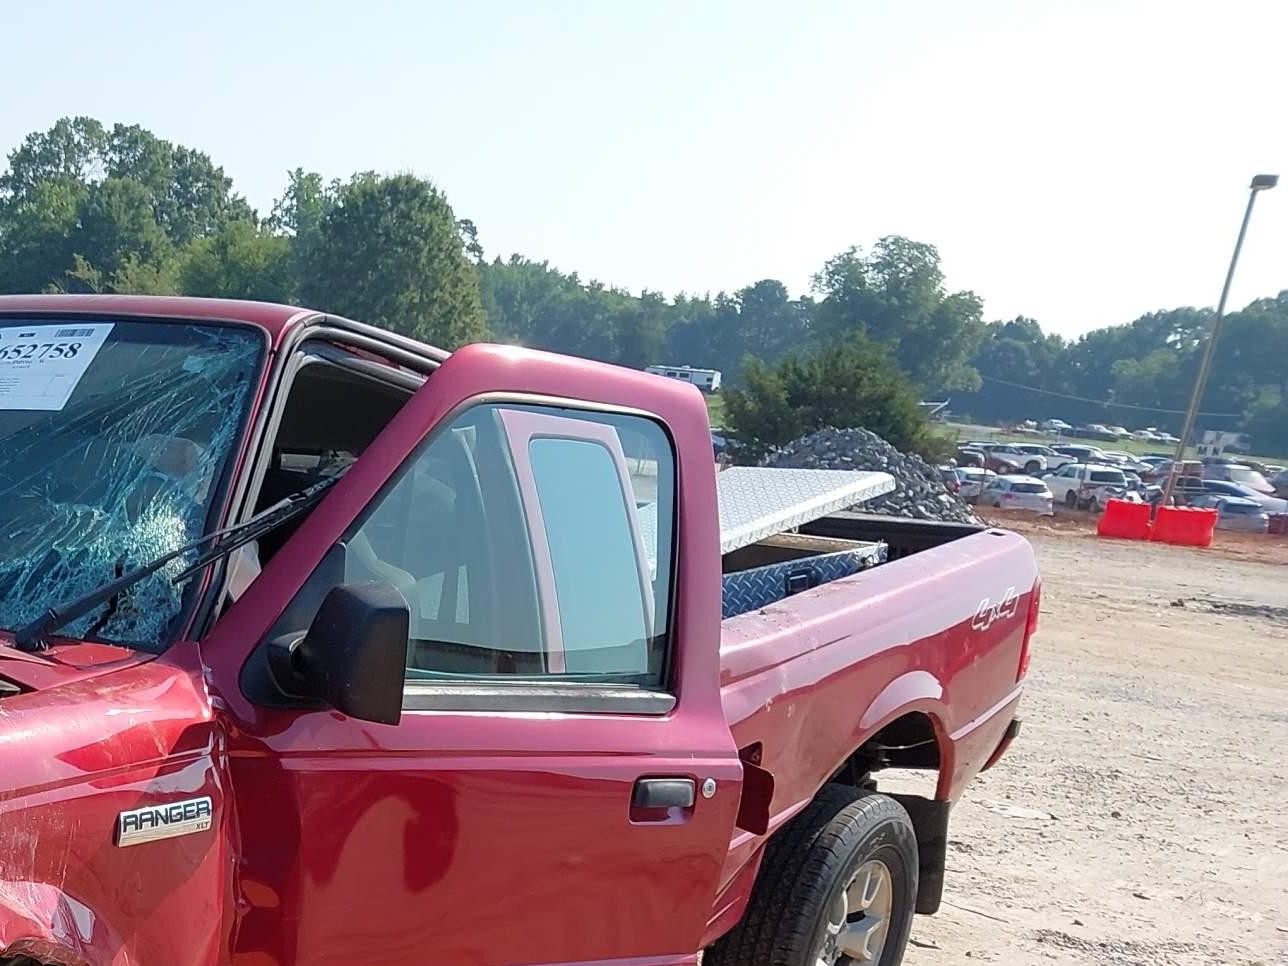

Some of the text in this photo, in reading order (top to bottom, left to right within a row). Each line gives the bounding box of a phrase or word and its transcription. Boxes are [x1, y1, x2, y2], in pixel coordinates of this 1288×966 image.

[971, 586, 1020, 631] 4x4
[123, 800, 211, 833] RANGER
[195, 821, 210, 830] XLT
